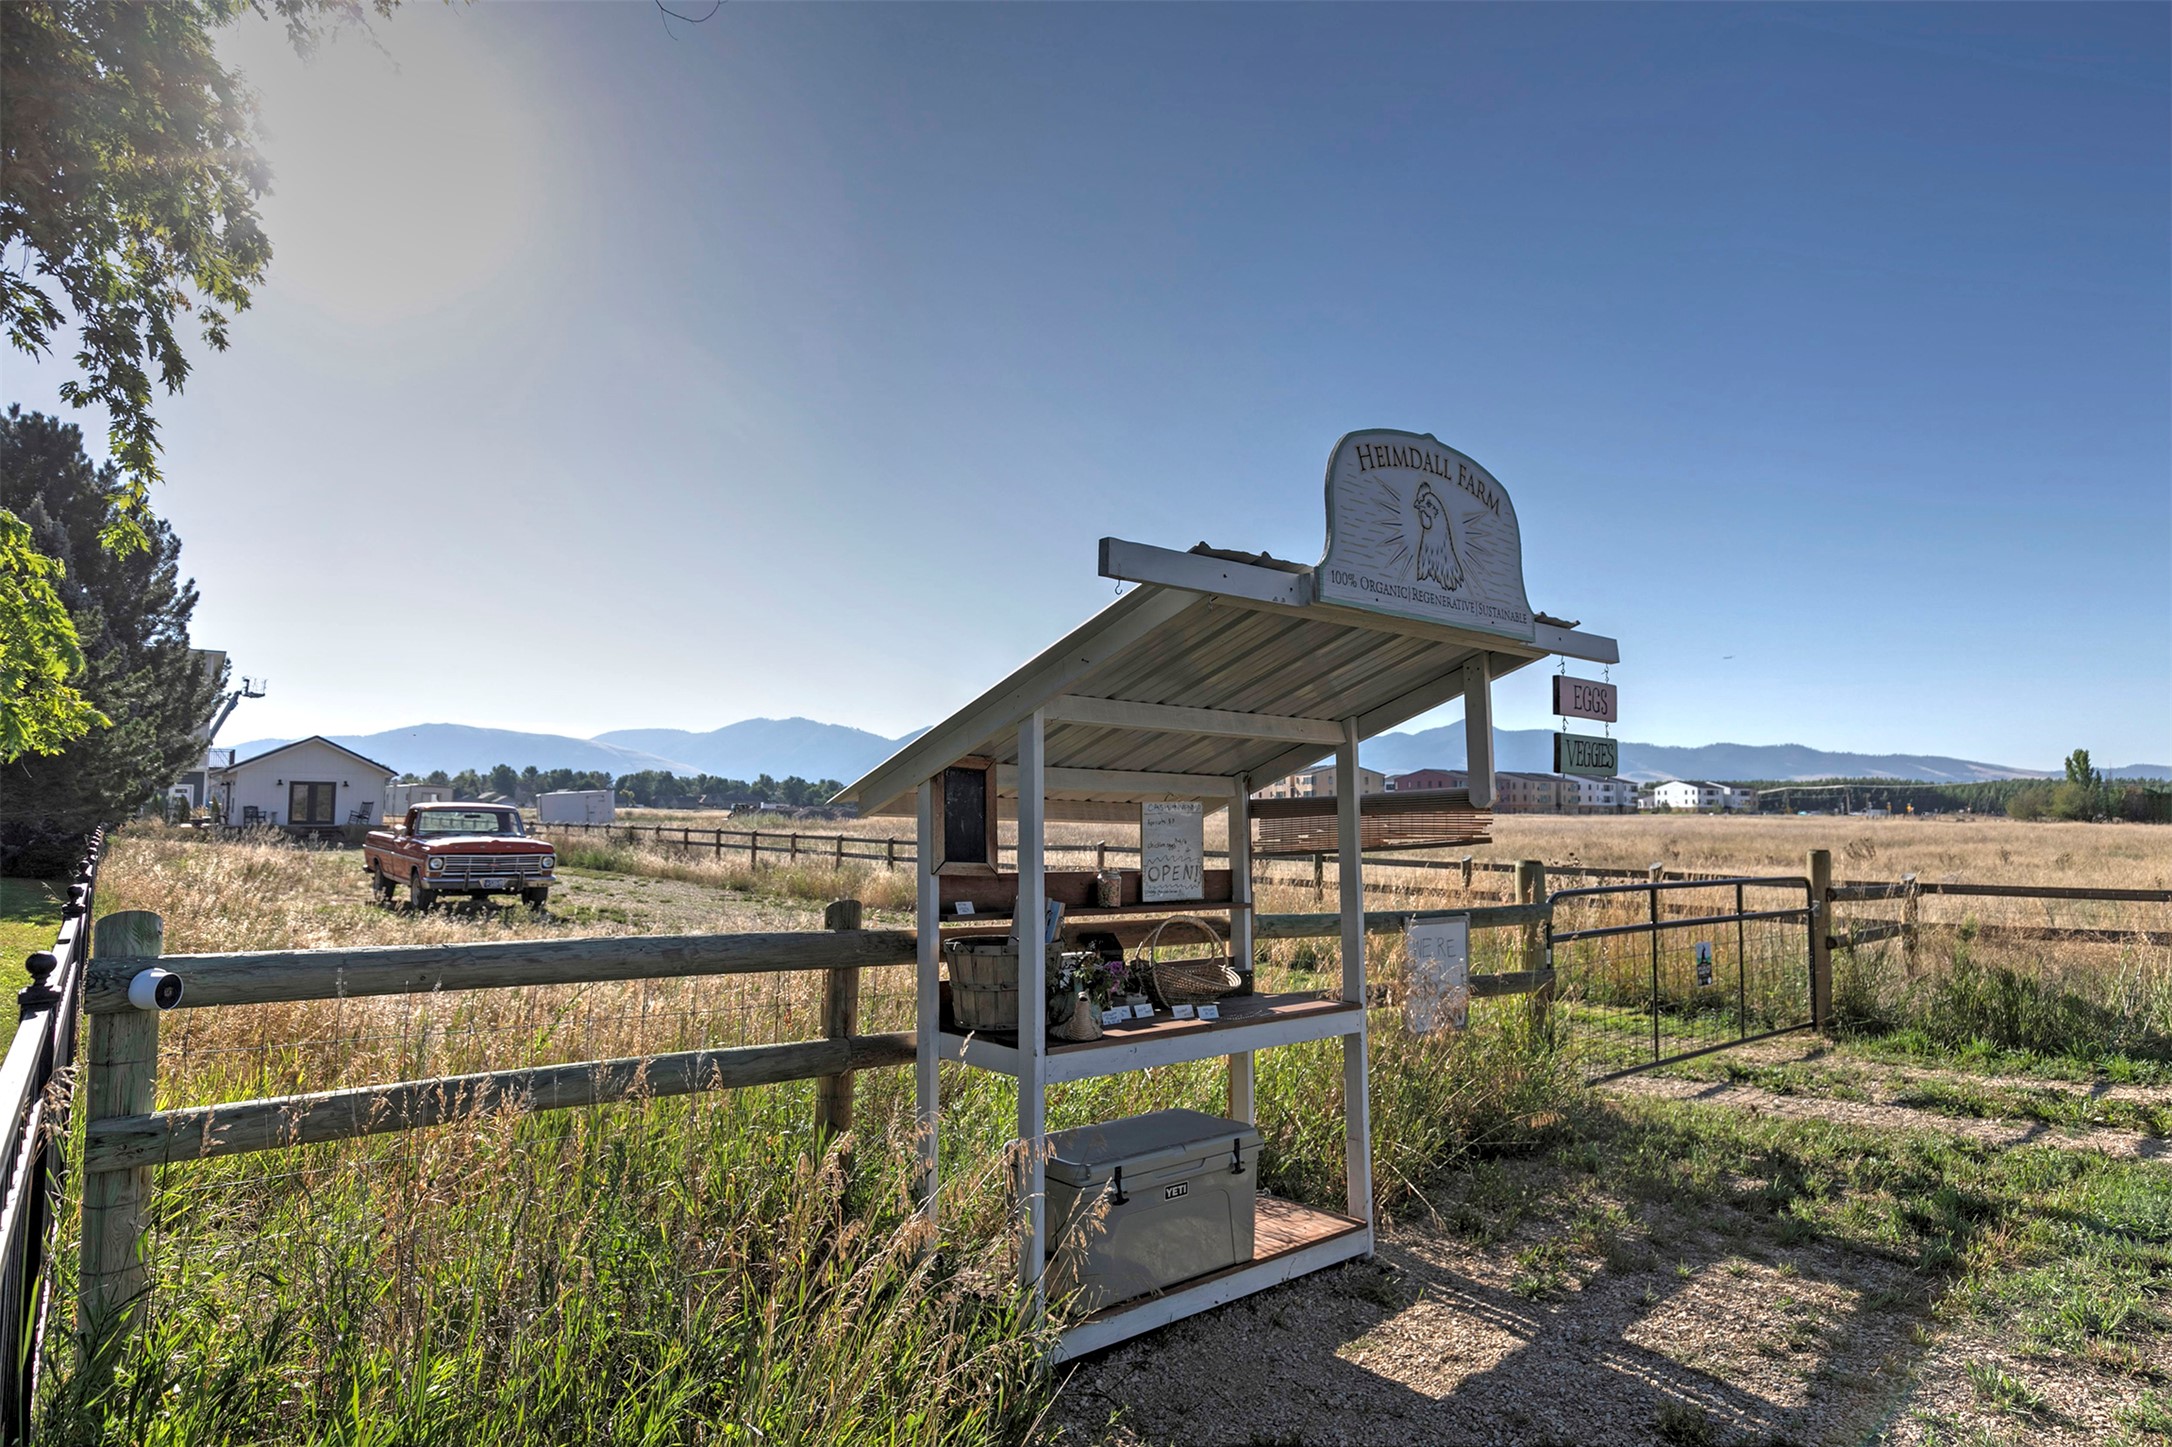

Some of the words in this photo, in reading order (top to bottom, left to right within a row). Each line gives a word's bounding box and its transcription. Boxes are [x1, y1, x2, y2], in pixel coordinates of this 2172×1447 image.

[1356, 443, 1452, 481] HEIMDALL
[1457, 462, 1500, 516] FARM
[1331, 569, 1357, 588] 100%
[1573, 684, 1608, 715] EGGS
[1566, 739, 1615, 769] VEGGIES
[1148, 864, 1199, 882] OPEN!
[1166, 1184, 1187, 1197] YETI
